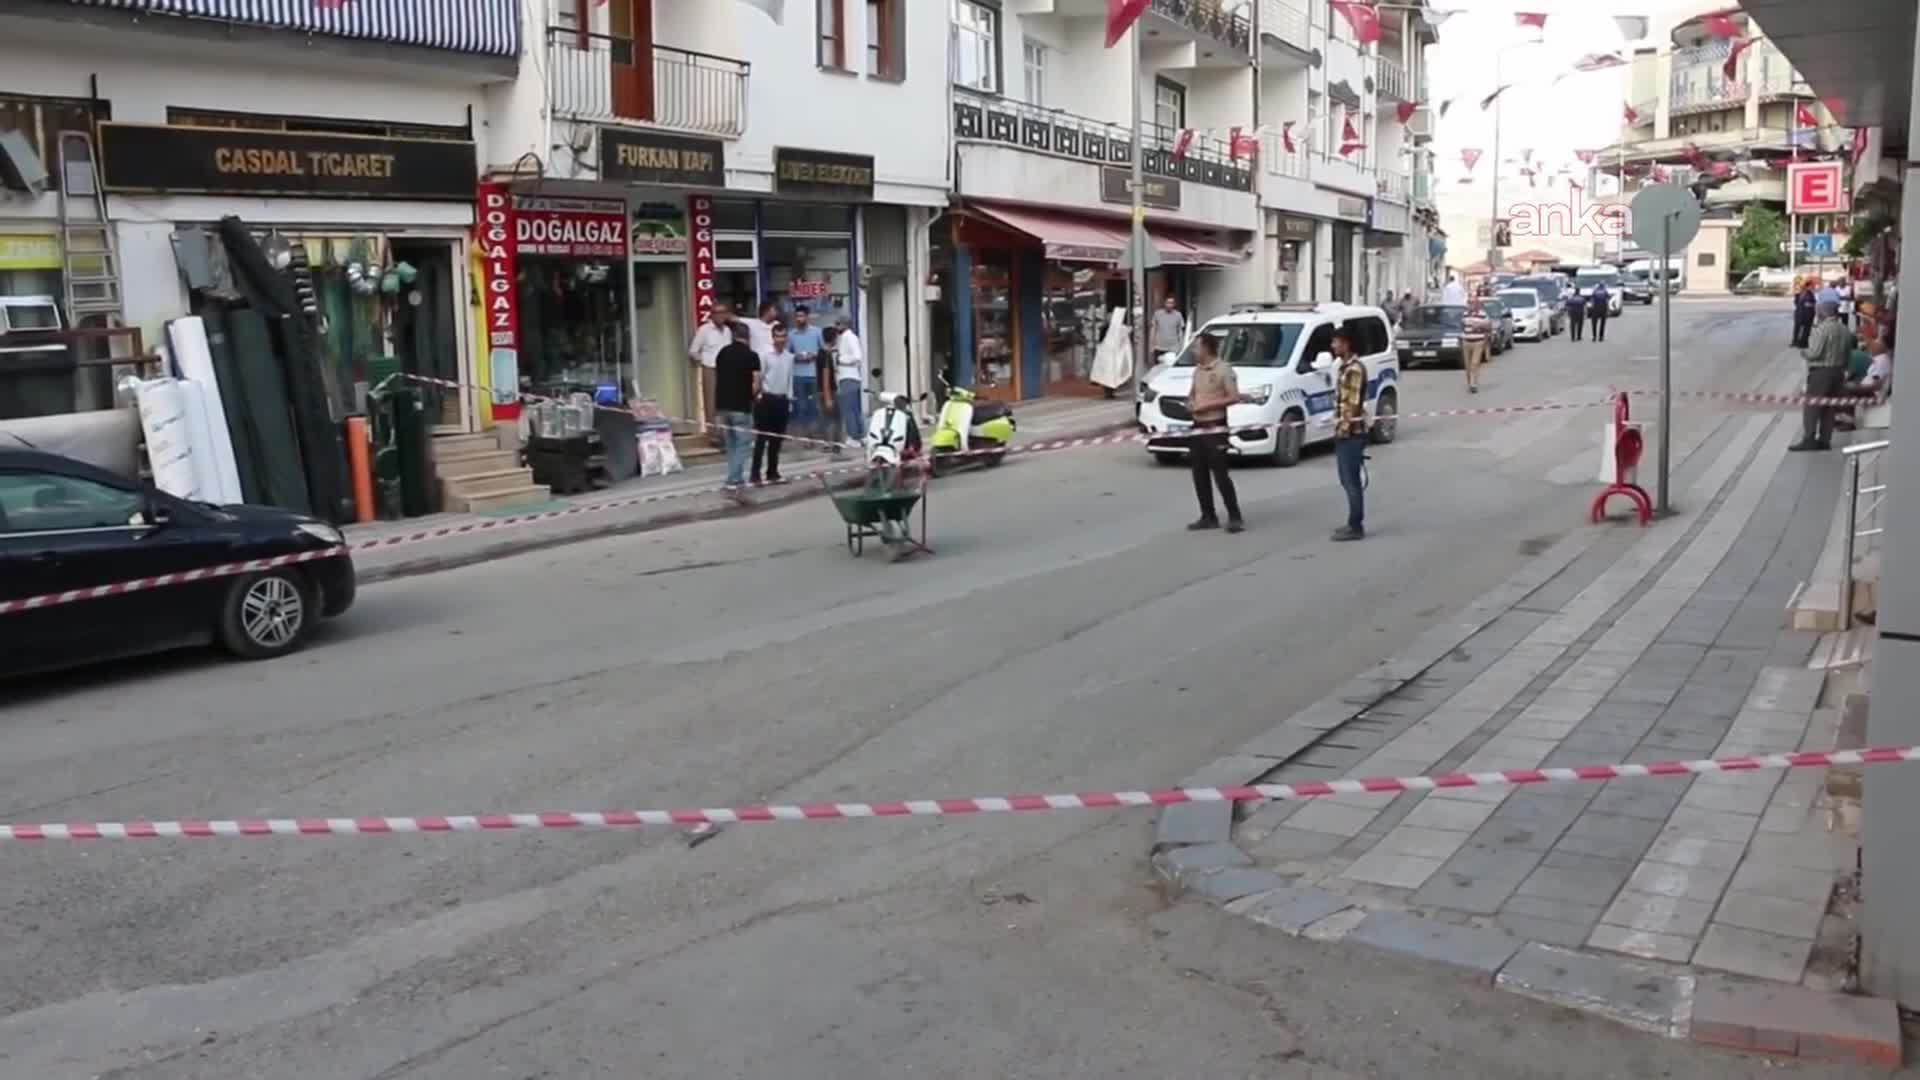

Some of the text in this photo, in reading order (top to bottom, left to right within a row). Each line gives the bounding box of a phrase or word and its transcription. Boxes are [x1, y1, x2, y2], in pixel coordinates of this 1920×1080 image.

[215, 147, 395, 177] CASDAL TİCARET
[616, 144, 713, 172] FURKAN YAPI
[1801, 173, 1829, 203] E
[516, 213, 624, 243] DOĞALGAZ
